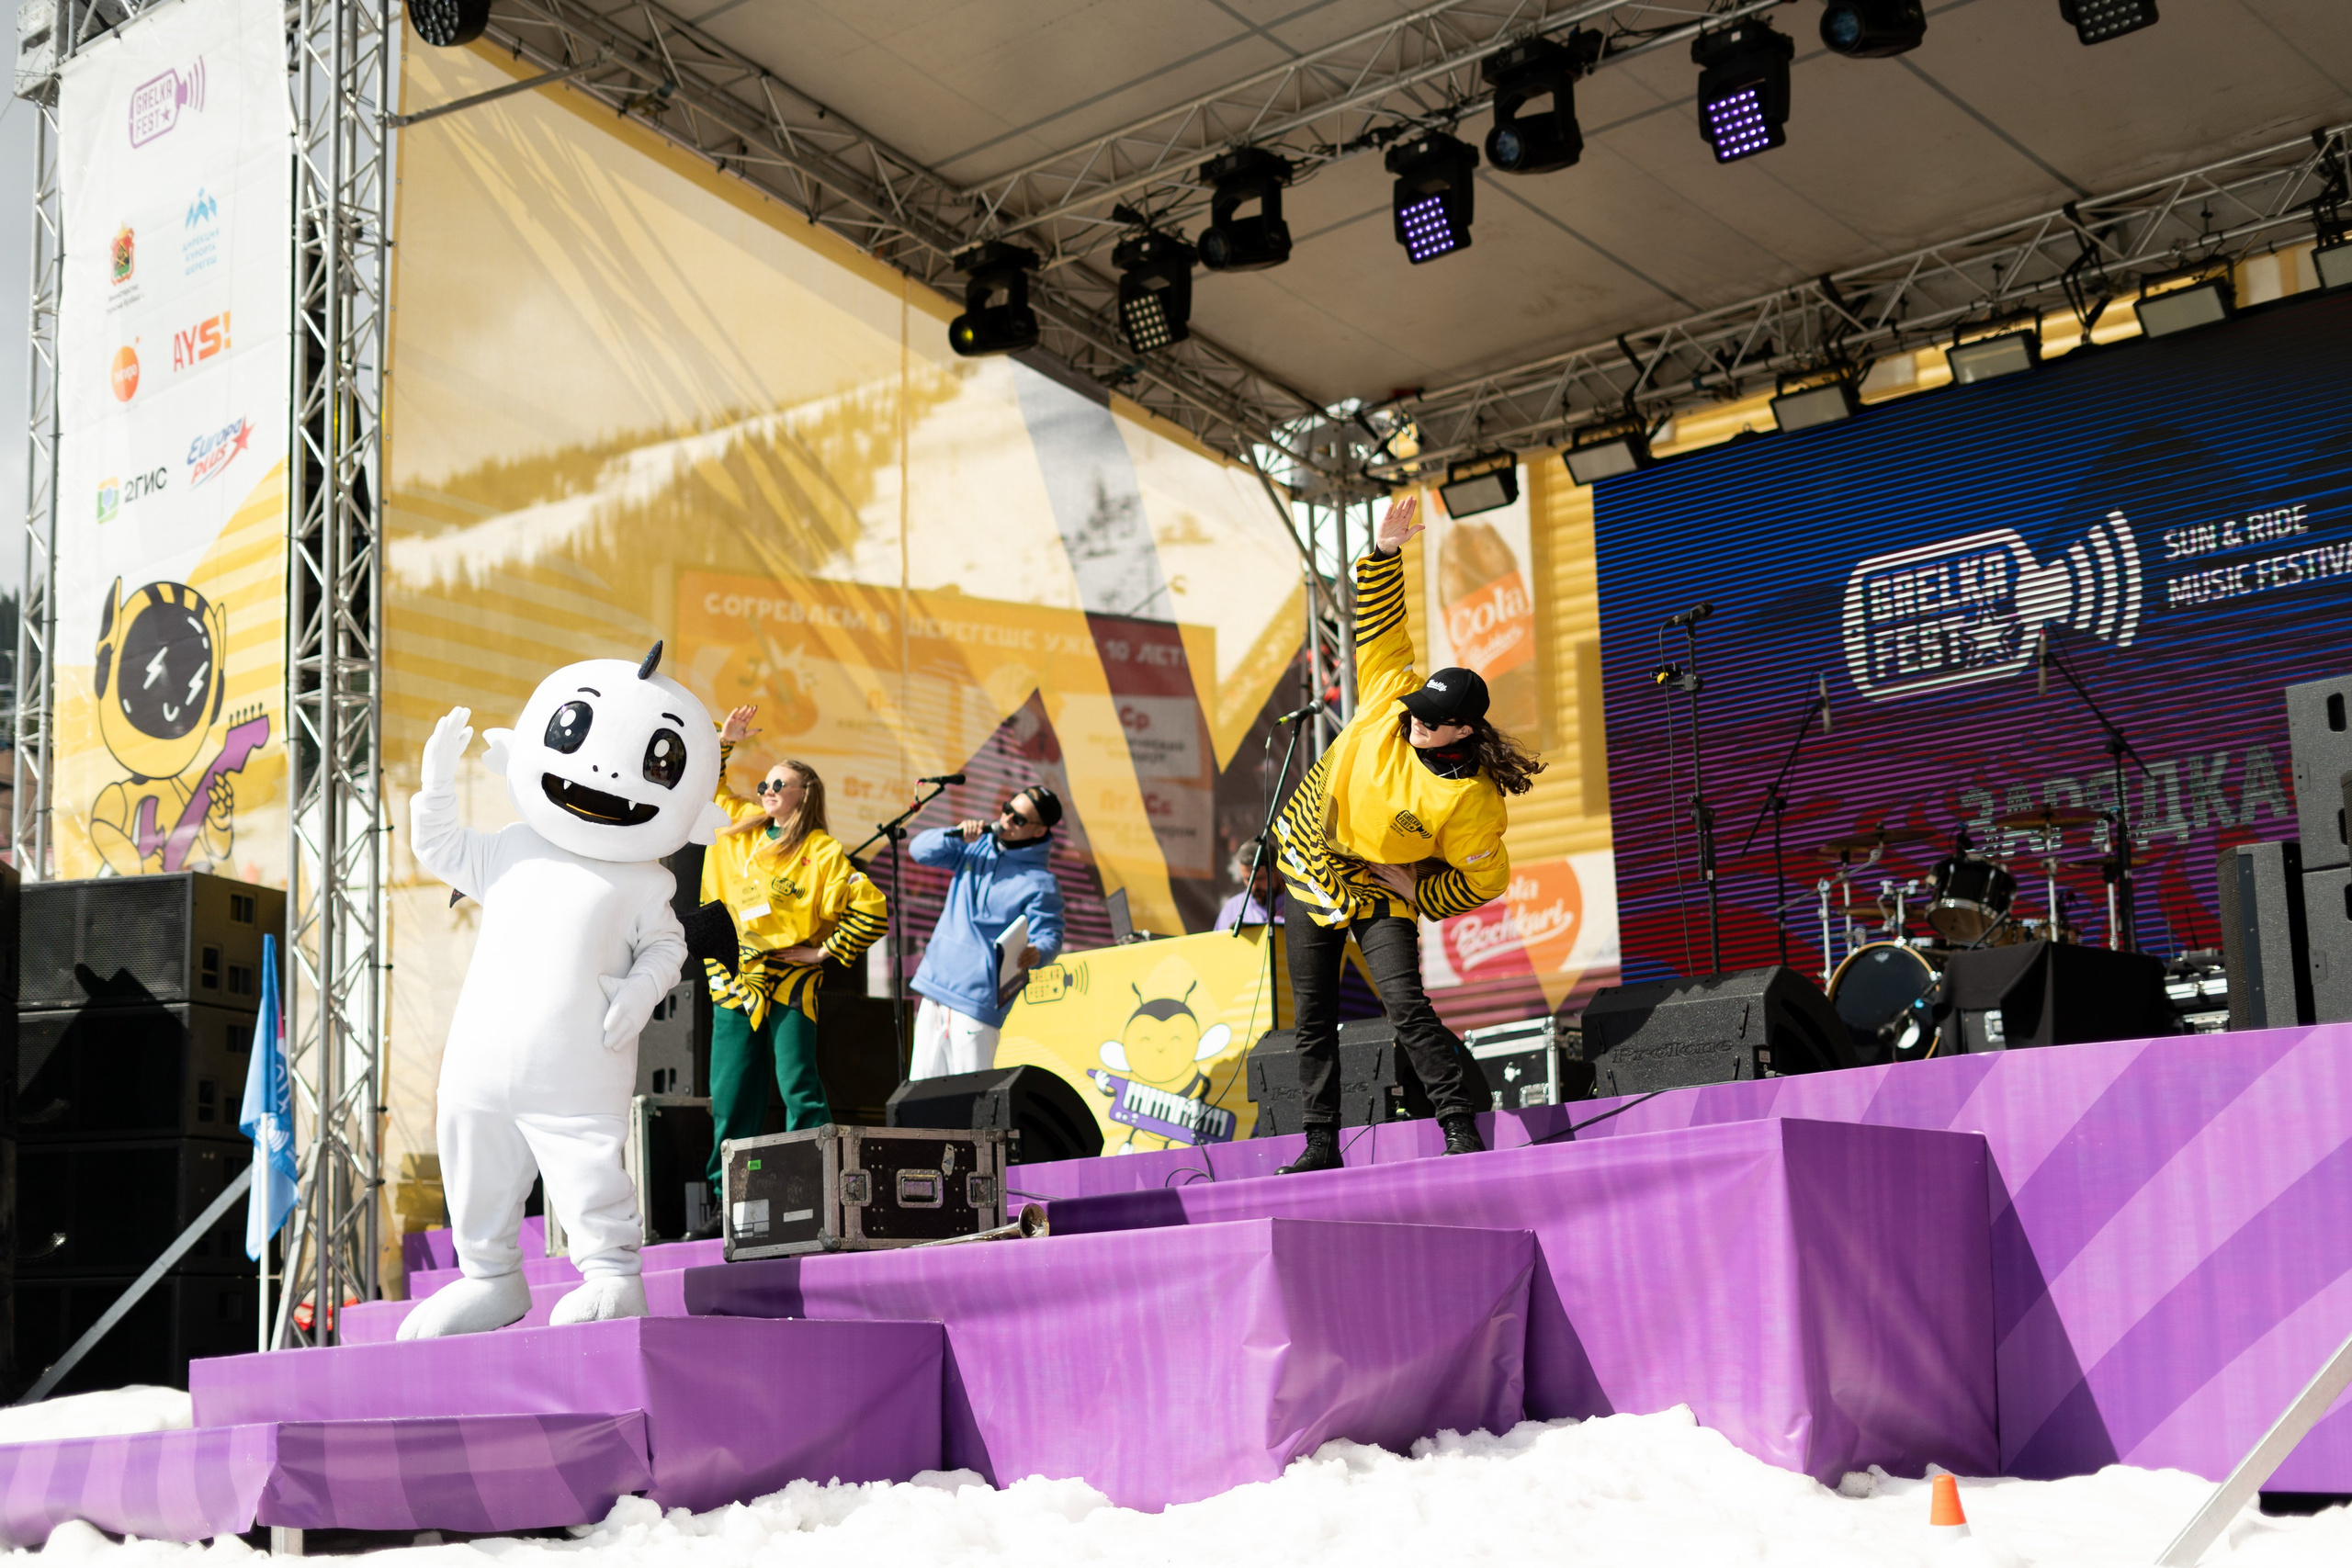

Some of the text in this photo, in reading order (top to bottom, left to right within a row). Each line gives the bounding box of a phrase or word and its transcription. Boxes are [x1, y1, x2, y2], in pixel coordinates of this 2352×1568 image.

[136, 77, 173, 115] GRELKA
[136, 108, 160, 139] FEST
[174, 310, 232, 373] AYS!
[124, 467, 167, 502] 2ГИС
[2163, 504, 2309, 561] SUN & RIDE
[1870, 551, 2008, 625] GRELKA
[2167, 562, 2252, 609] MUSIC
[1450, 585, 1533, 648] Cola
[1873, 615, 1966, 678] FEST
[1483, 874, 1540, 908] ola
[1611, 1040, 1734, 1064] ProTone
